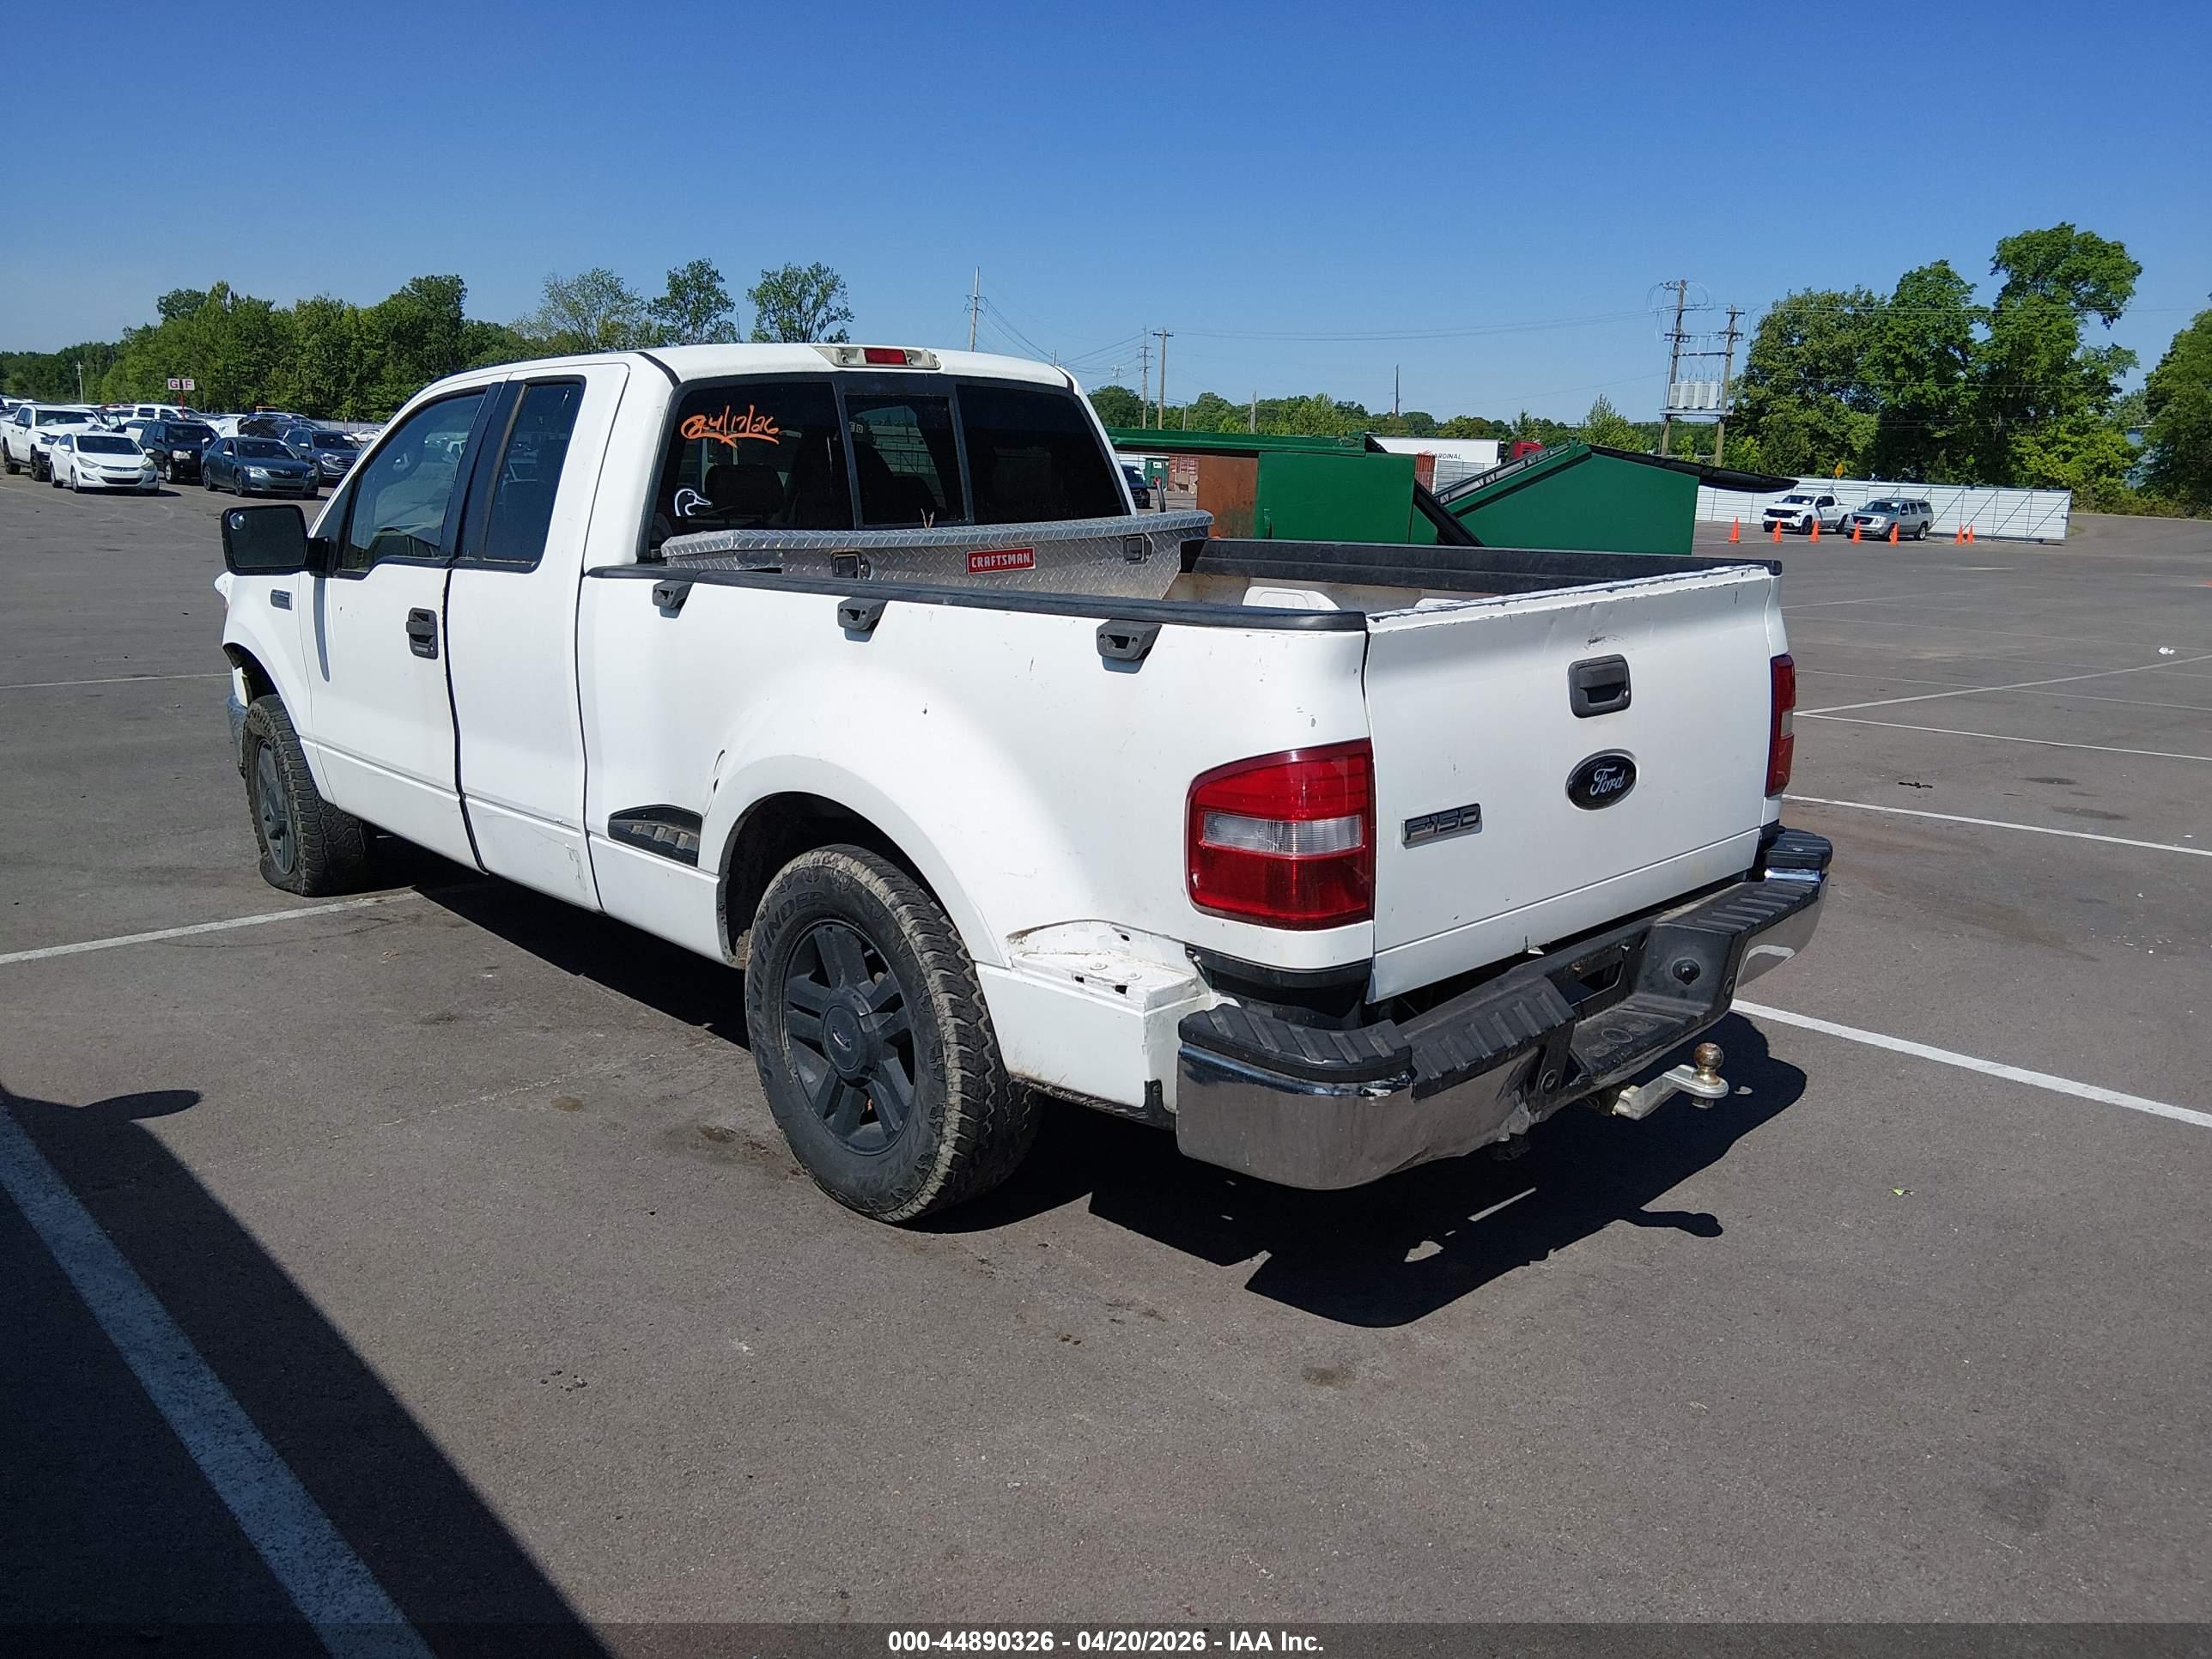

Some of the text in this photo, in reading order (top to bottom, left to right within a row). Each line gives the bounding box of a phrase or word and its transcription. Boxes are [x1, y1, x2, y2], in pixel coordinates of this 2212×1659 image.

[169, 379, 179, 389] G
[971, 552, 1030, 568] CRAFTSMAN
[1589, 766, 1626, 796] Ford
